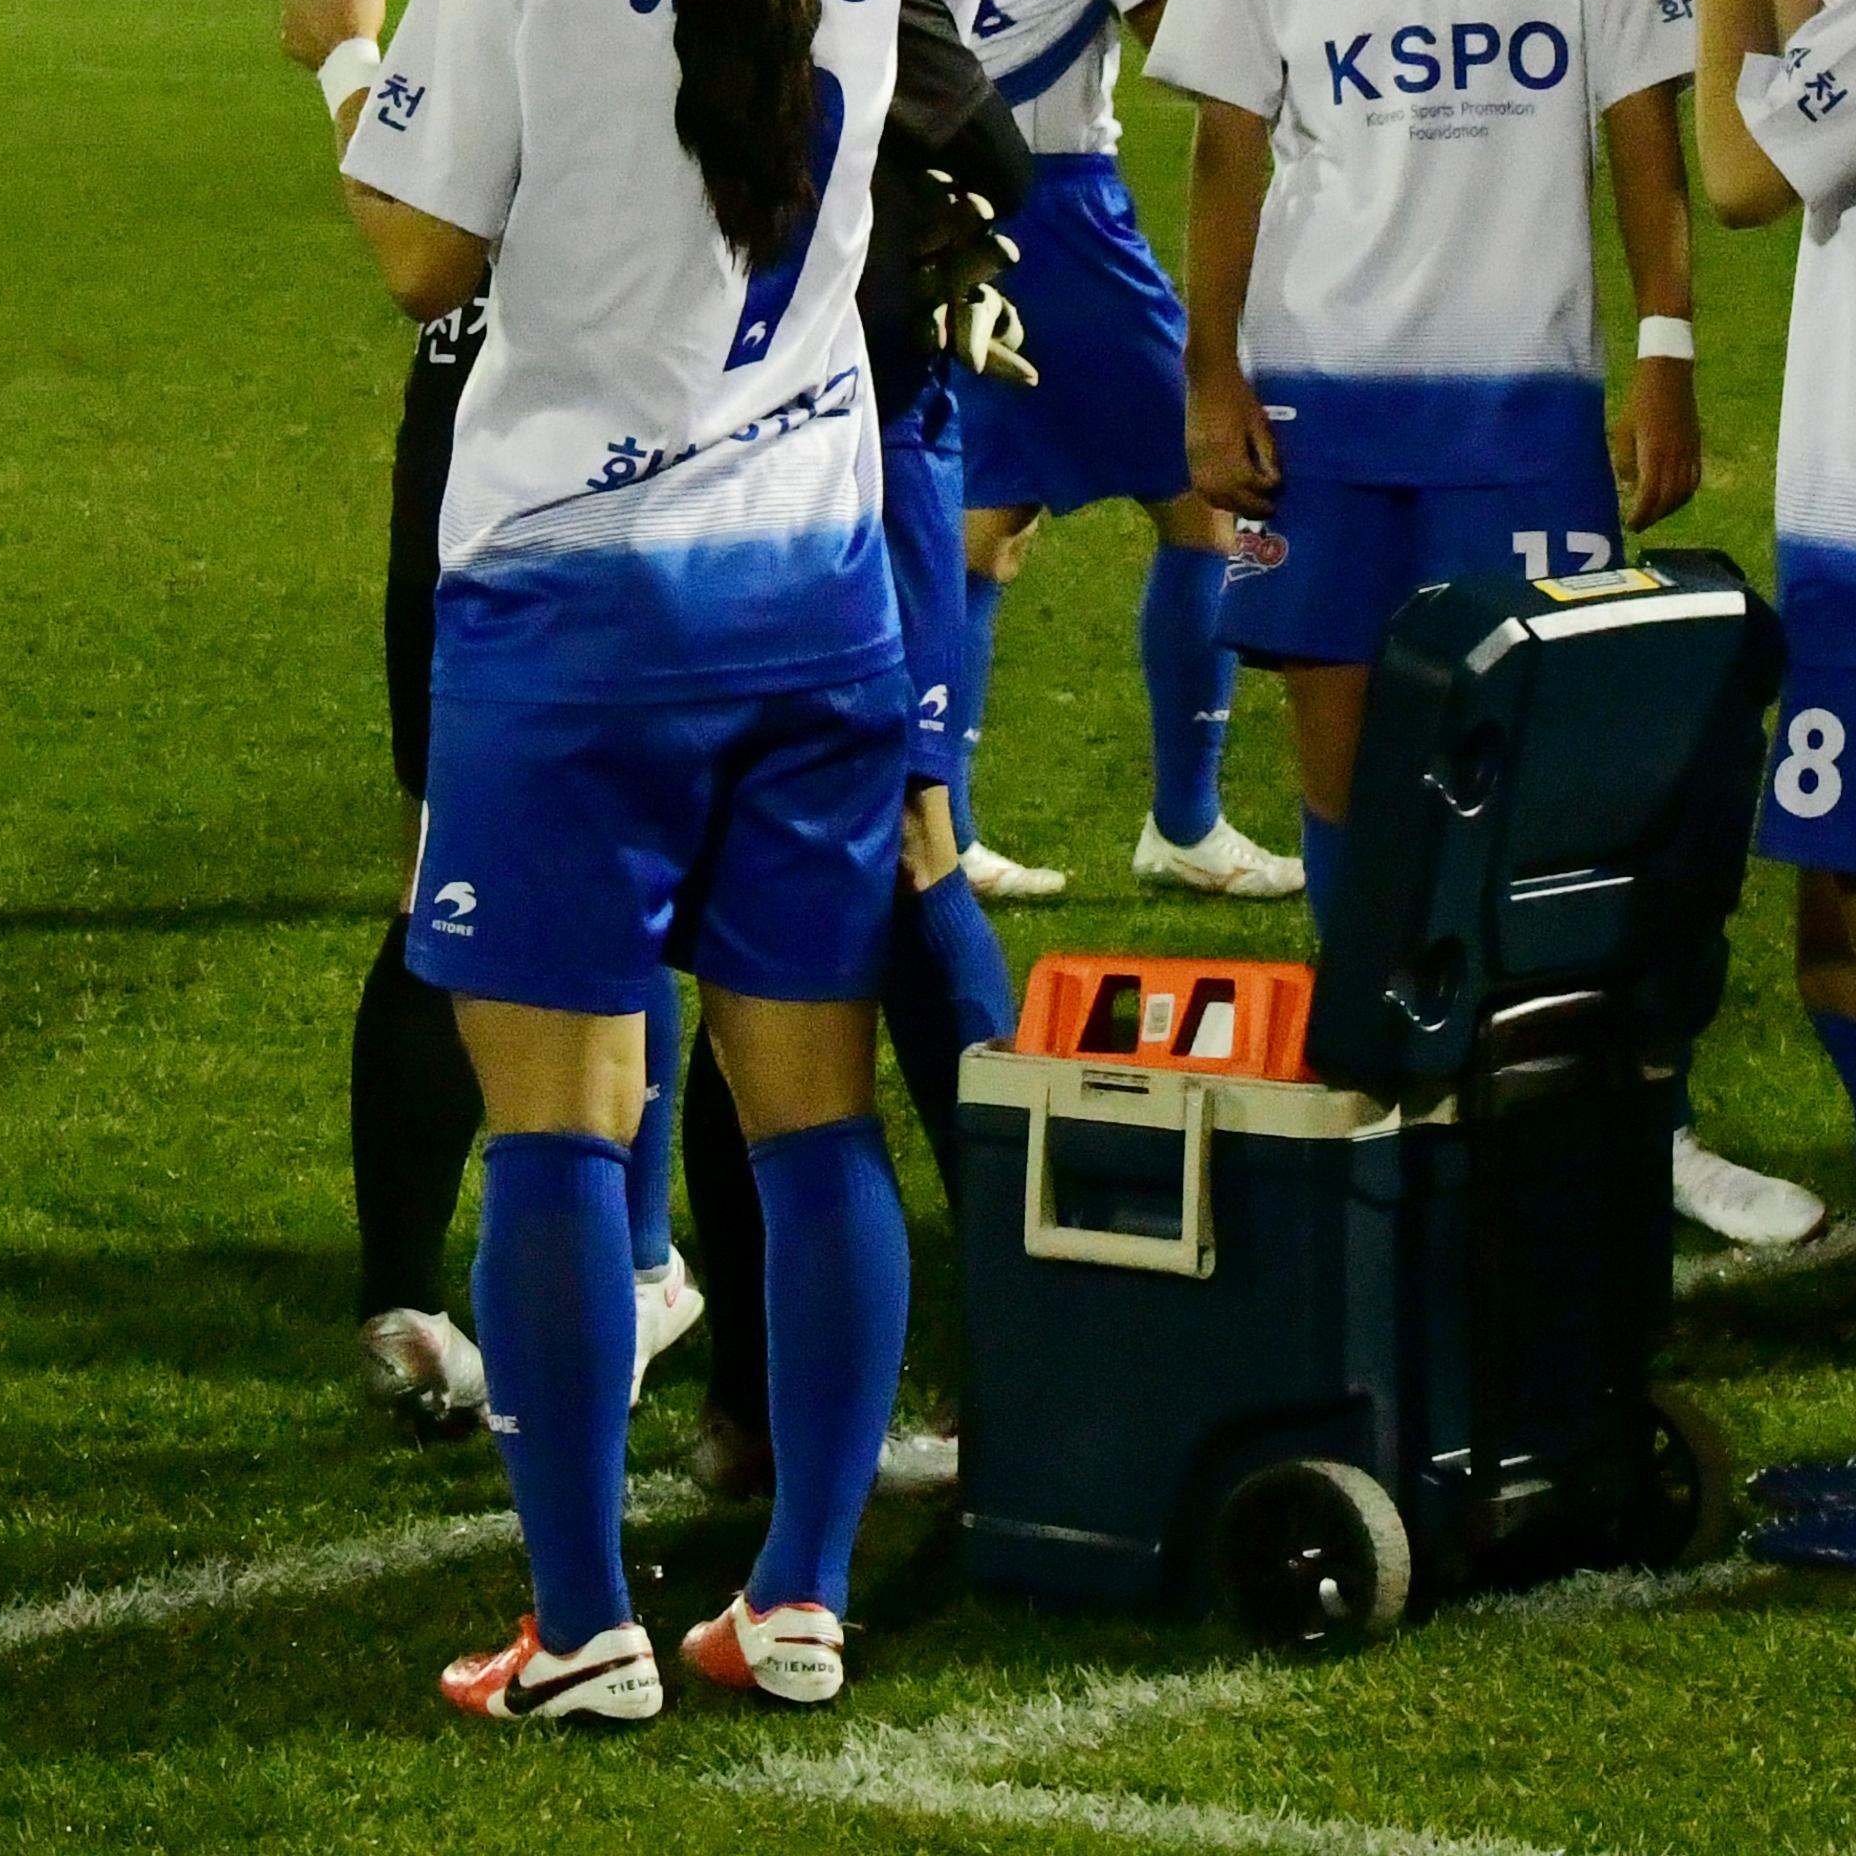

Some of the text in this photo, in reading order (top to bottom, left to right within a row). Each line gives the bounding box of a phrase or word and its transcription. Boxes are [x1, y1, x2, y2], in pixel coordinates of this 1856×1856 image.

[1325, 21, 1568, 105] KSPO
[1409, 125, 1489, 142] Foundation
[1774, 707, 1846, 819] 8
